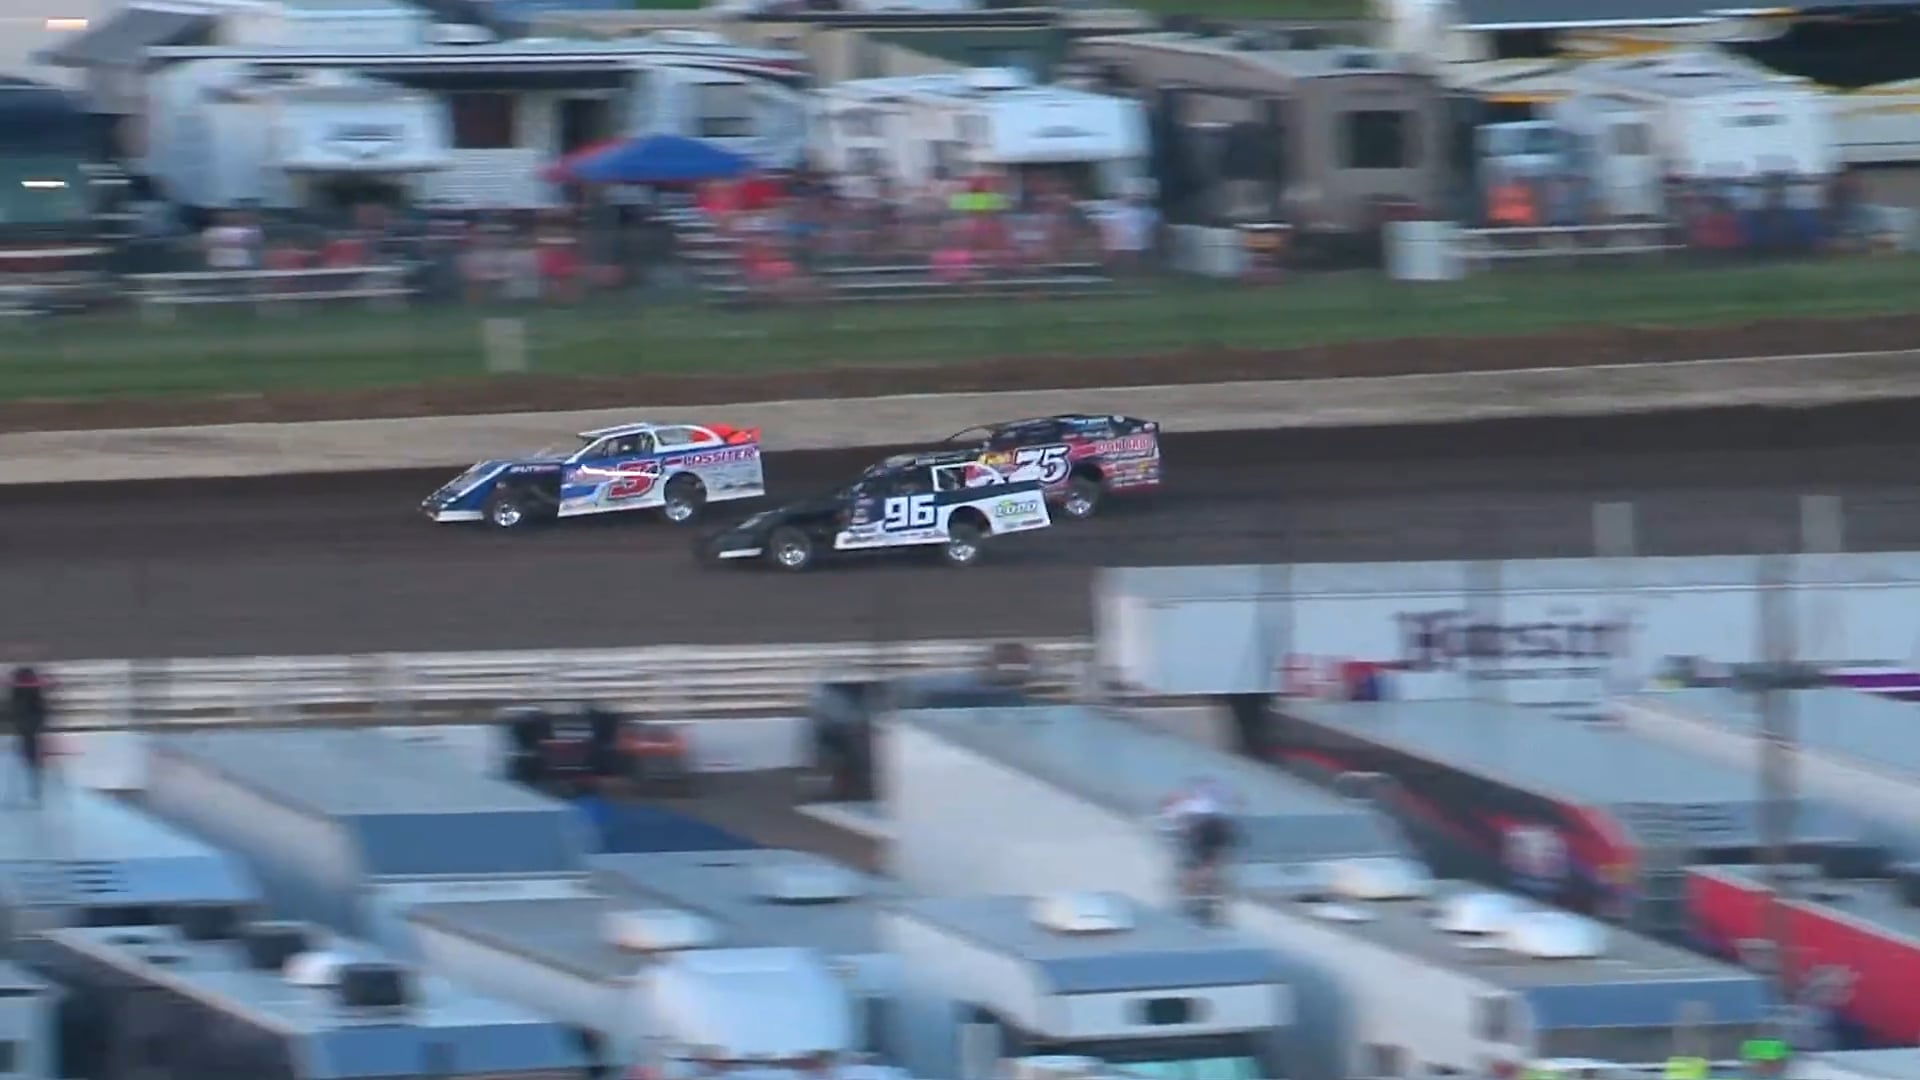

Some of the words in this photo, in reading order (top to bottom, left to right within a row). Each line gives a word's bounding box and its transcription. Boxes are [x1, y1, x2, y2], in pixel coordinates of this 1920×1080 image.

[682, 447, 755, 466] LASSITER
[1007, 445, 1071, 484] 75
[883, 493, 936, 531] 96
